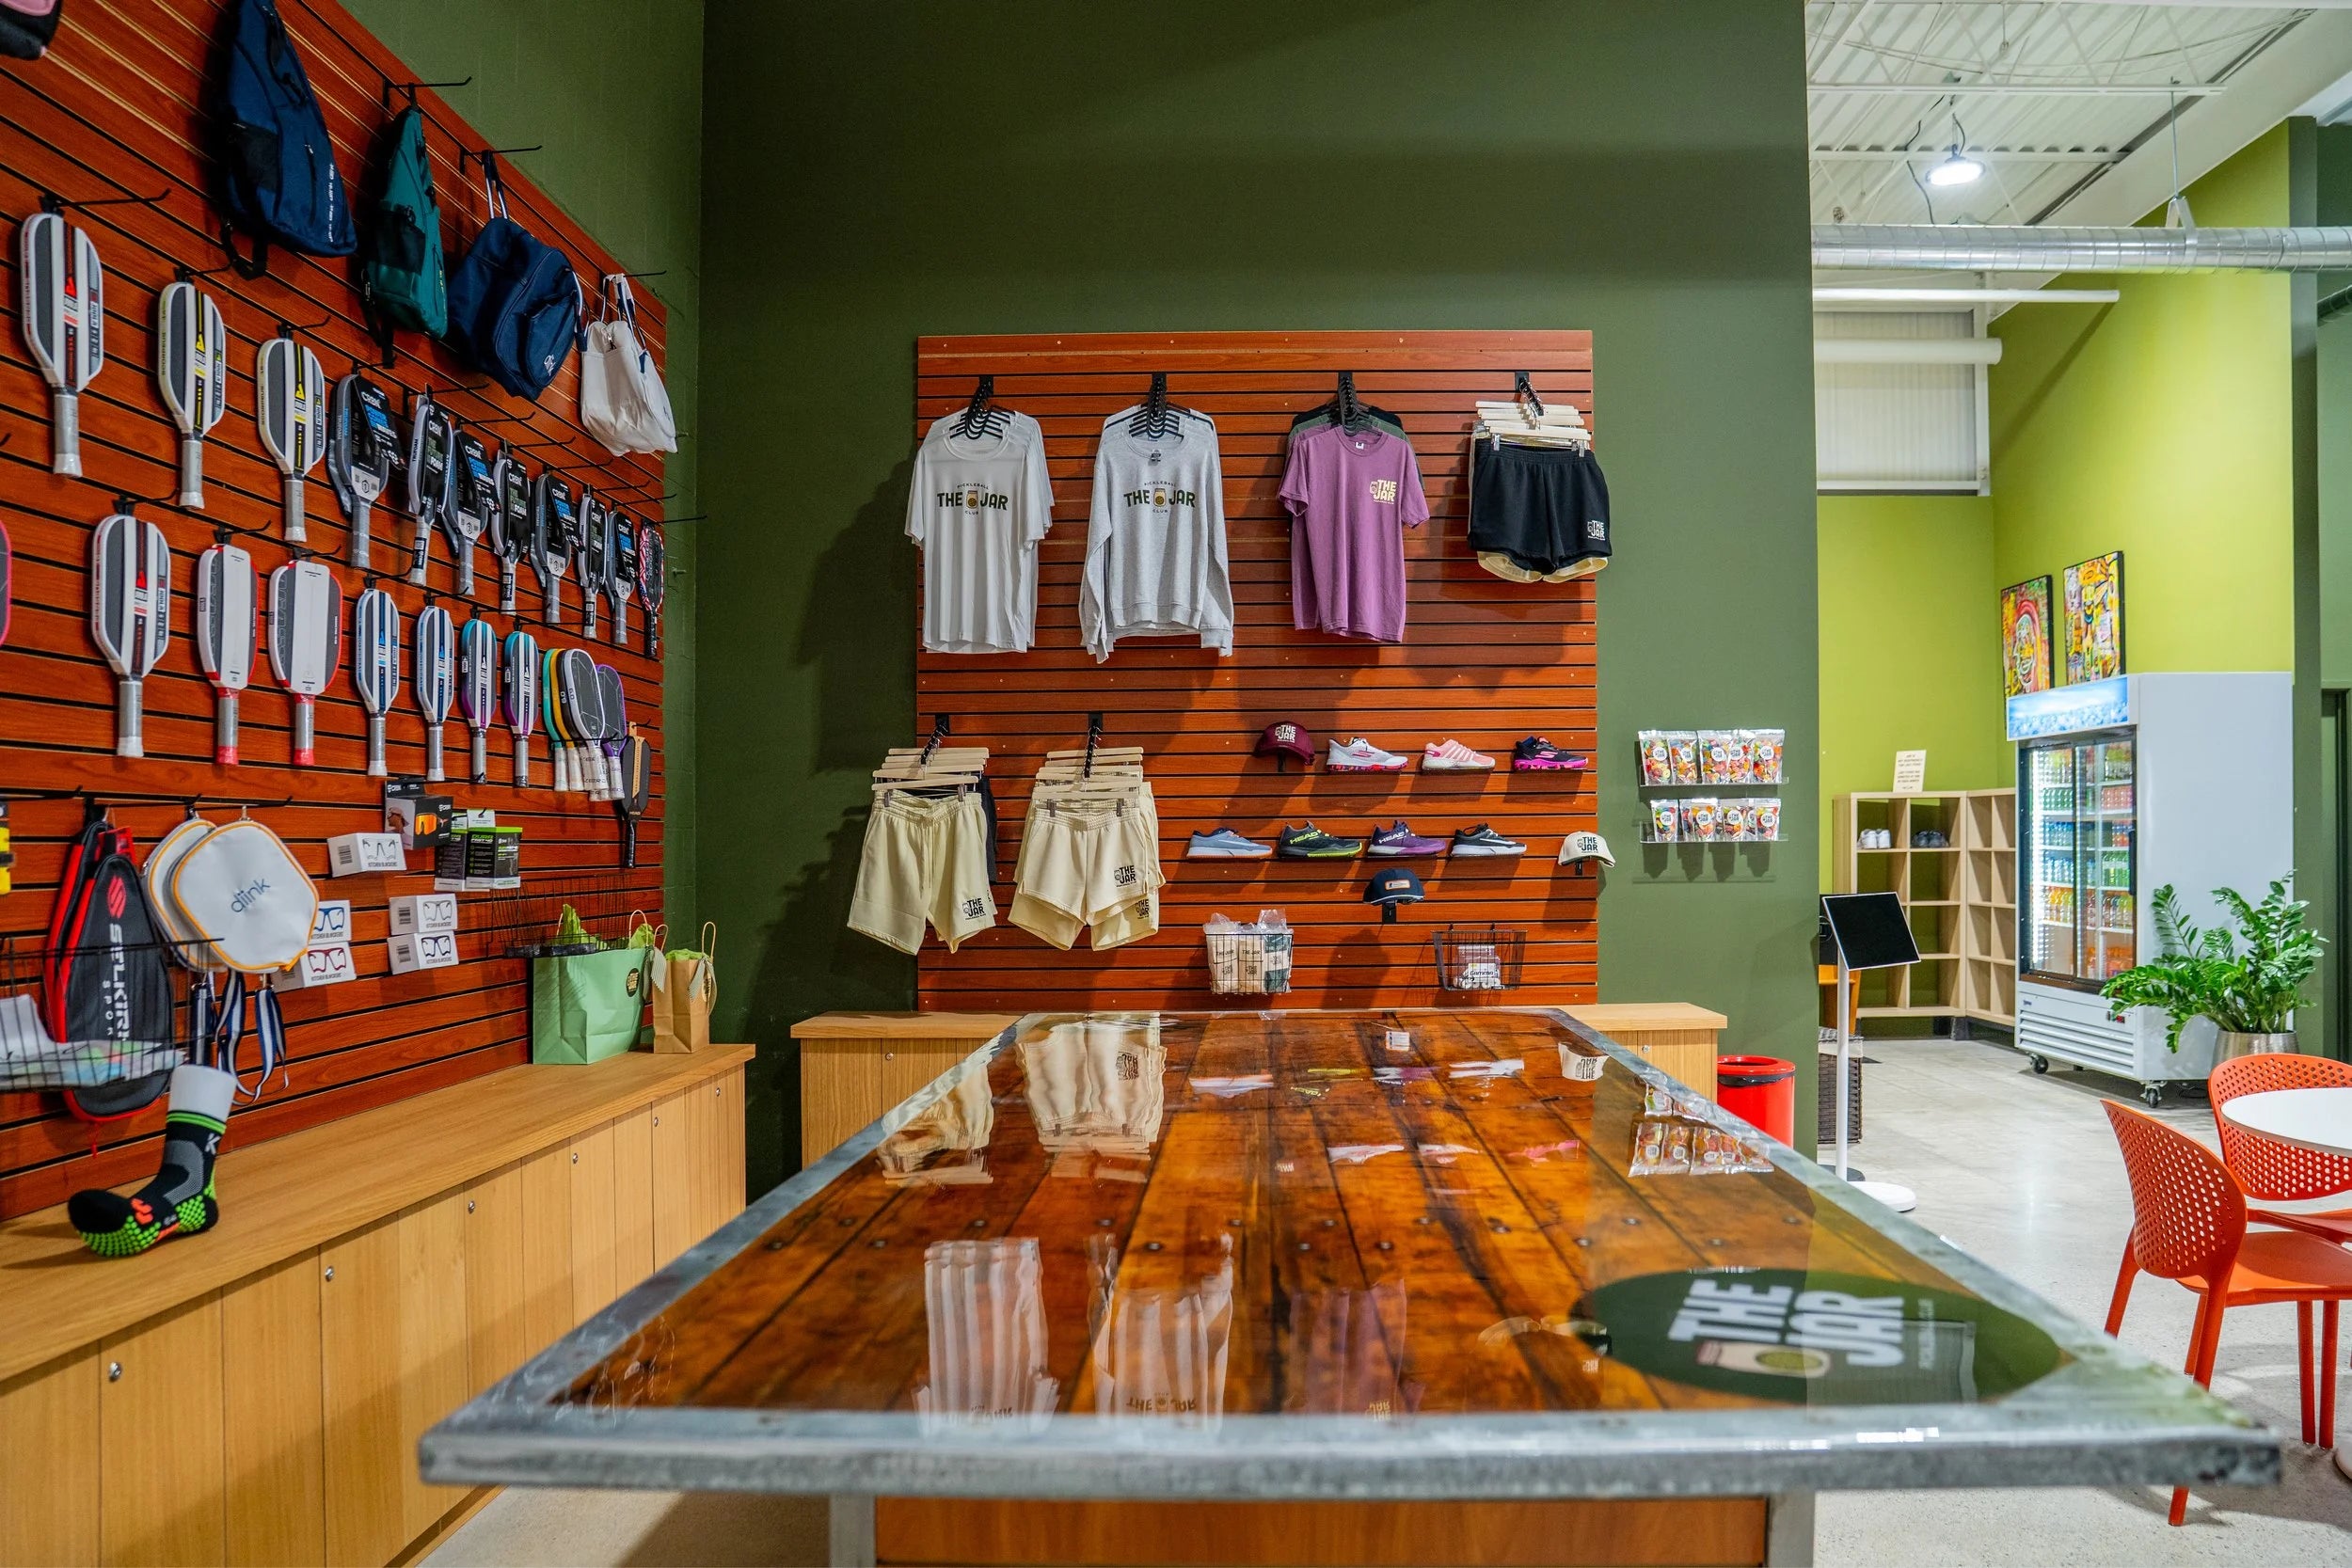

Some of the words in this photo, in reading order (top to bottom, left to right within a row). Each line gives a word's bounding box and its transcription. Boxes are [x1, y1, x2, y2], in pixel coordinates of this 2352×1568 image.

[1377, 480, 1397, 492] THE
[937, 492, 963, 507] THE
[980, 493, 1009, 511] JAR
[1123, 490, 1151, 508] THE
[1168, 490, 1196, 508] JAR
[1374, 489, 1396, 502] JAR
[1592, 520, 1605, 531] THE
[1591, 529, 1605, 538] JAR
[1280, 724, 1296, 735] THE
[1278, 732, 1295, 741] JAR
[1290, 832, 1319, 845] HEAD
[1120, 864, 1136, 876] THE
[1120, 873, 1136, 884] JAR
[230, 879, 271, 912] diink
[967, 897, 983, 909] THE
[1138, 898, 1150, 908] THE
[968, 906, 985, 917] JAR
[1668, 1279, 1793, 1343] THE
[1785, 1291, 1904, 1367] JAR
